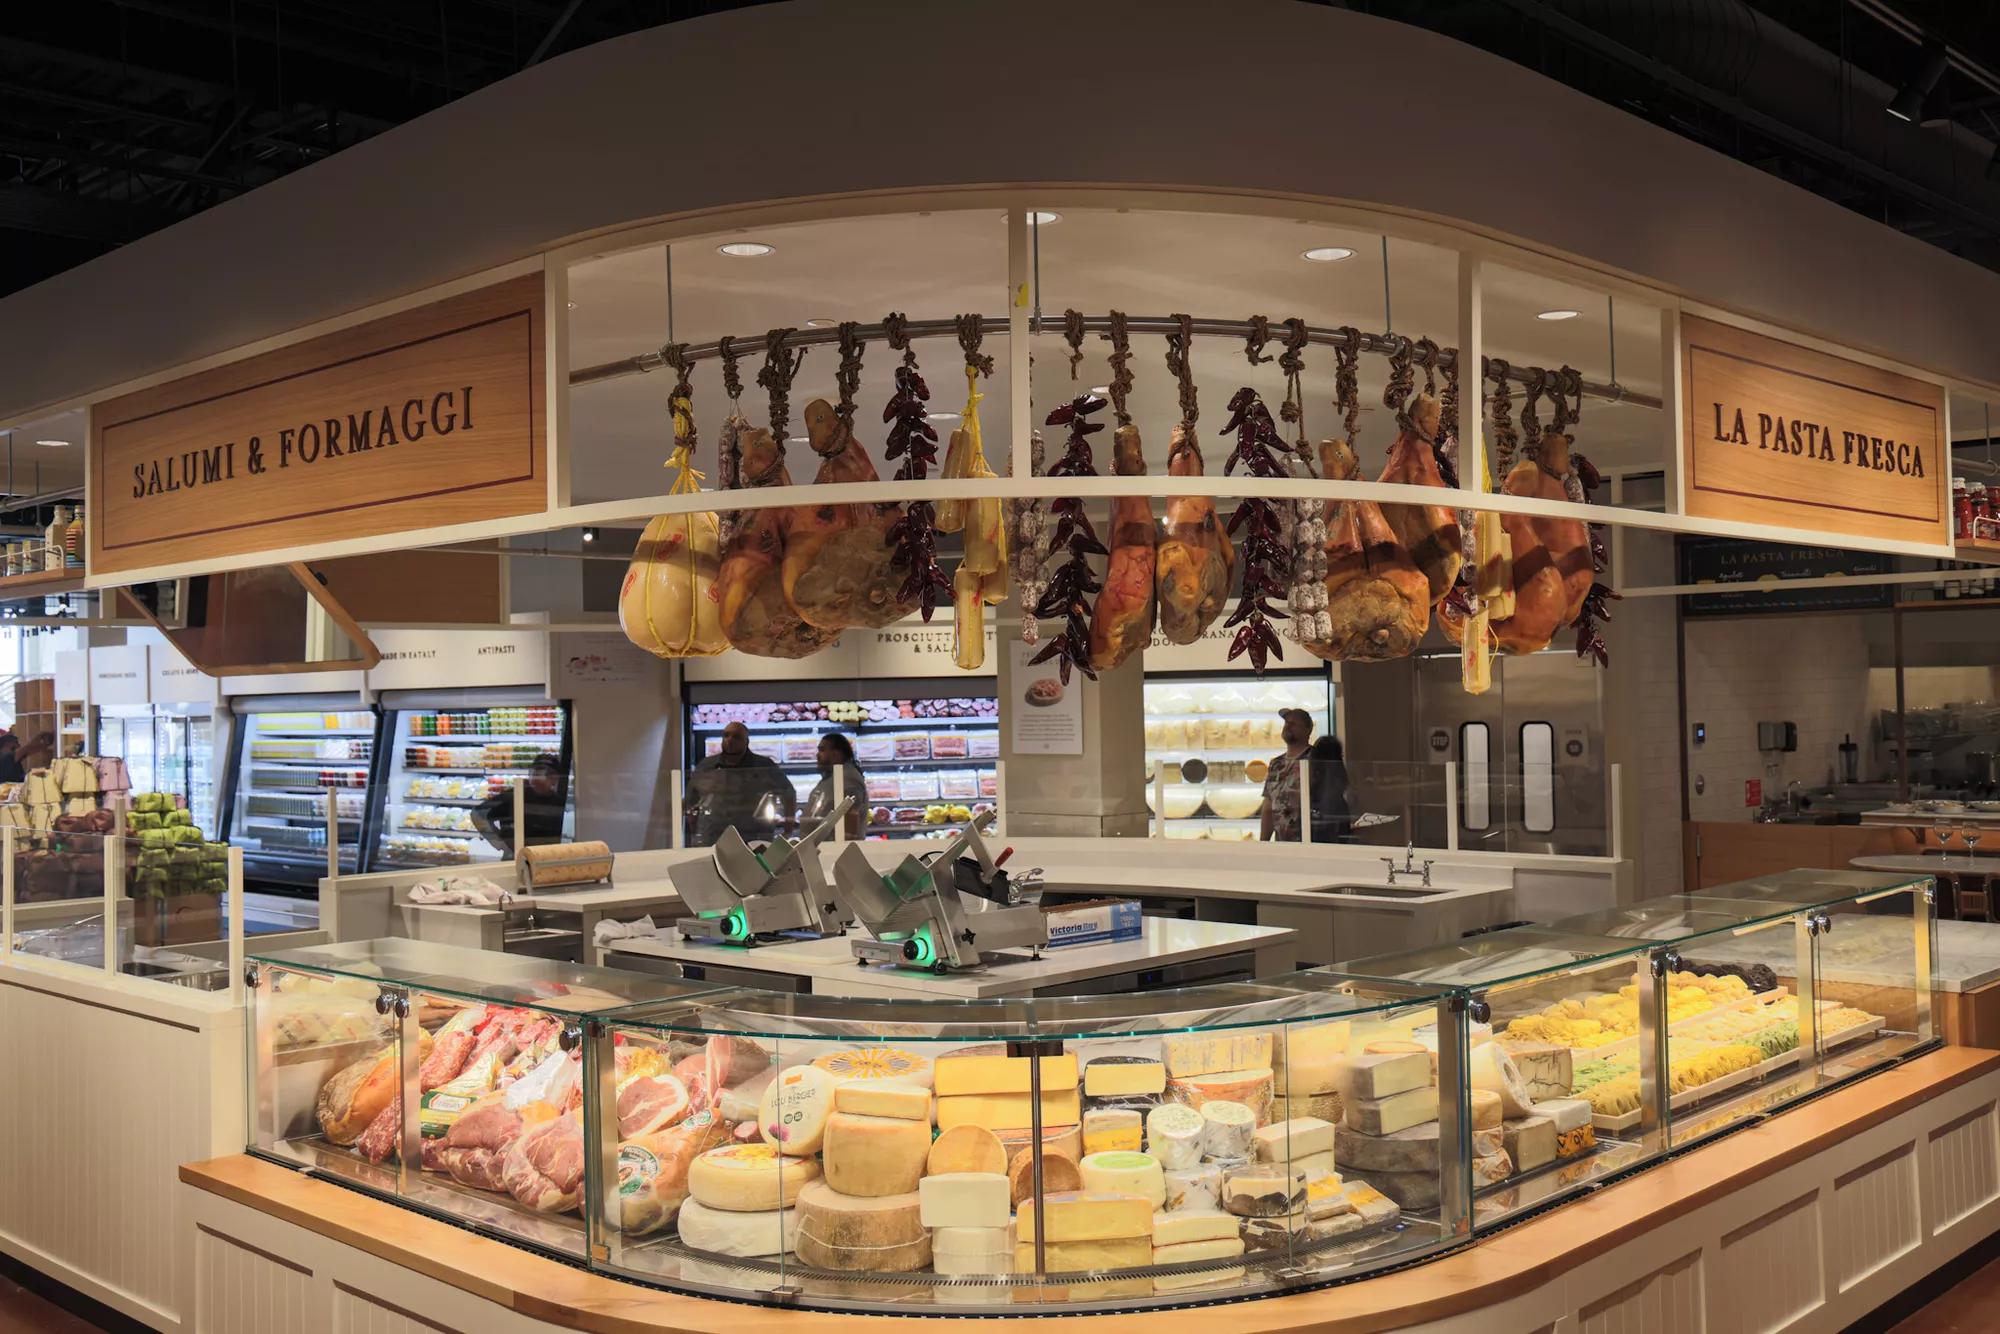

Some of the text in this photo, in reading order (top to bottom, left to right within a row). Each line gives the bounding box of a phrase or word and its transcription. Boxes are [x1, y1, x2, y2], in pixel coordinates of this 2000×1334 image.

[133, 386, 474, 498] SALUMI & FORMAGGI
[1713, 402, 1925, 478] LA PASTA FRESCA
[1721, 555, 1736, 564] LA
[1743, 552, 1784, 563] PASTA
[477, 645, 515, 655] ANTIPASTI
[914, 643, 921, 653] &
[408, 650, 436, 659] EATALY
[1050, 924, 1082, 934] Victoria
